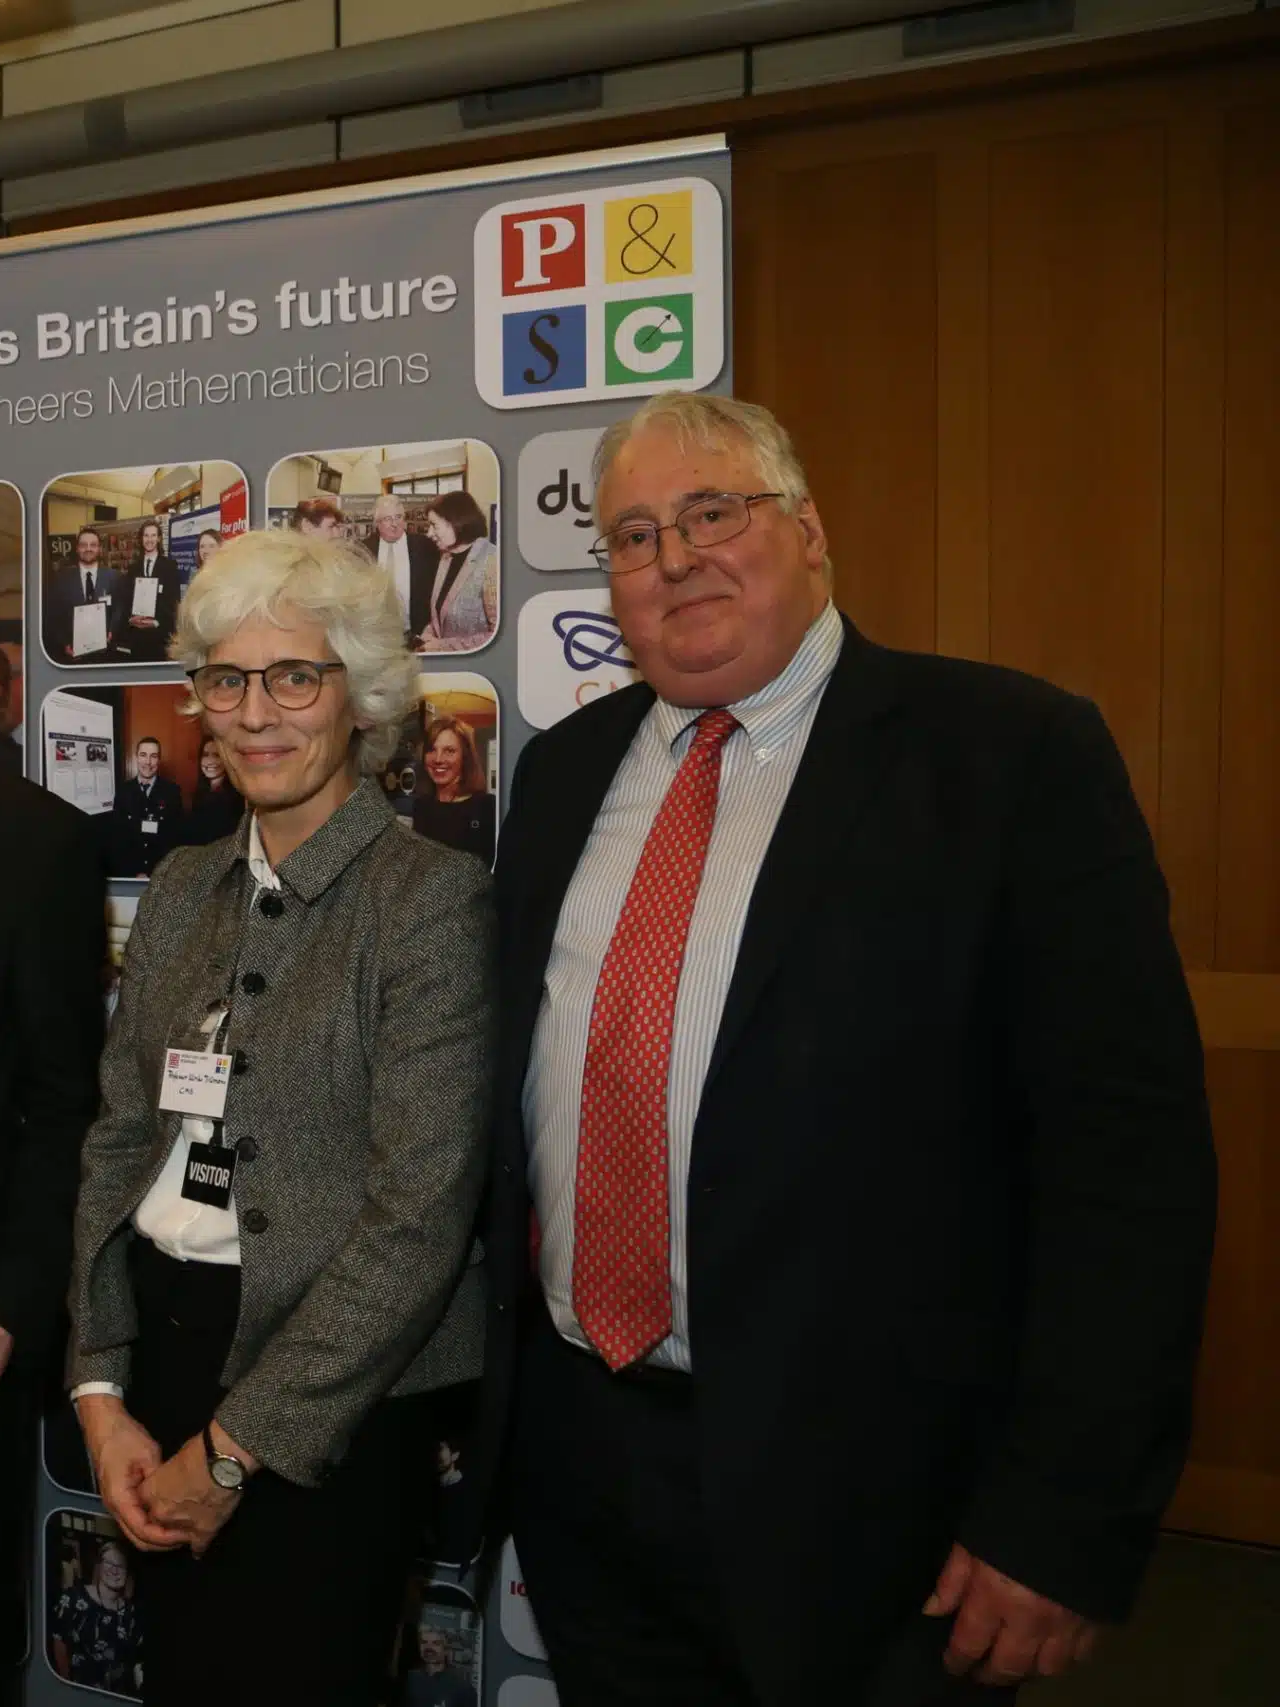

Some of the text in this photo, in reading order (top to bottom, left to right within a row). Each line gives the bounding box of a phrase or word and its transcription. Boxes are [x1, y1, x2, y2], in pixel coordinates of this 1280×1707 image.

[513, 203, 676, 288] P &
[37, 290, 258, 360] Britain's
[274, 273, 458, 330] future
[523, 306, 684, 385] S C
[108, 350, 430, 415] Mathematicians
[537, 469, 594, 528] dy
[51, 538, 72, 556] sip
[188, 1161, 231, 1189] VISITOR
